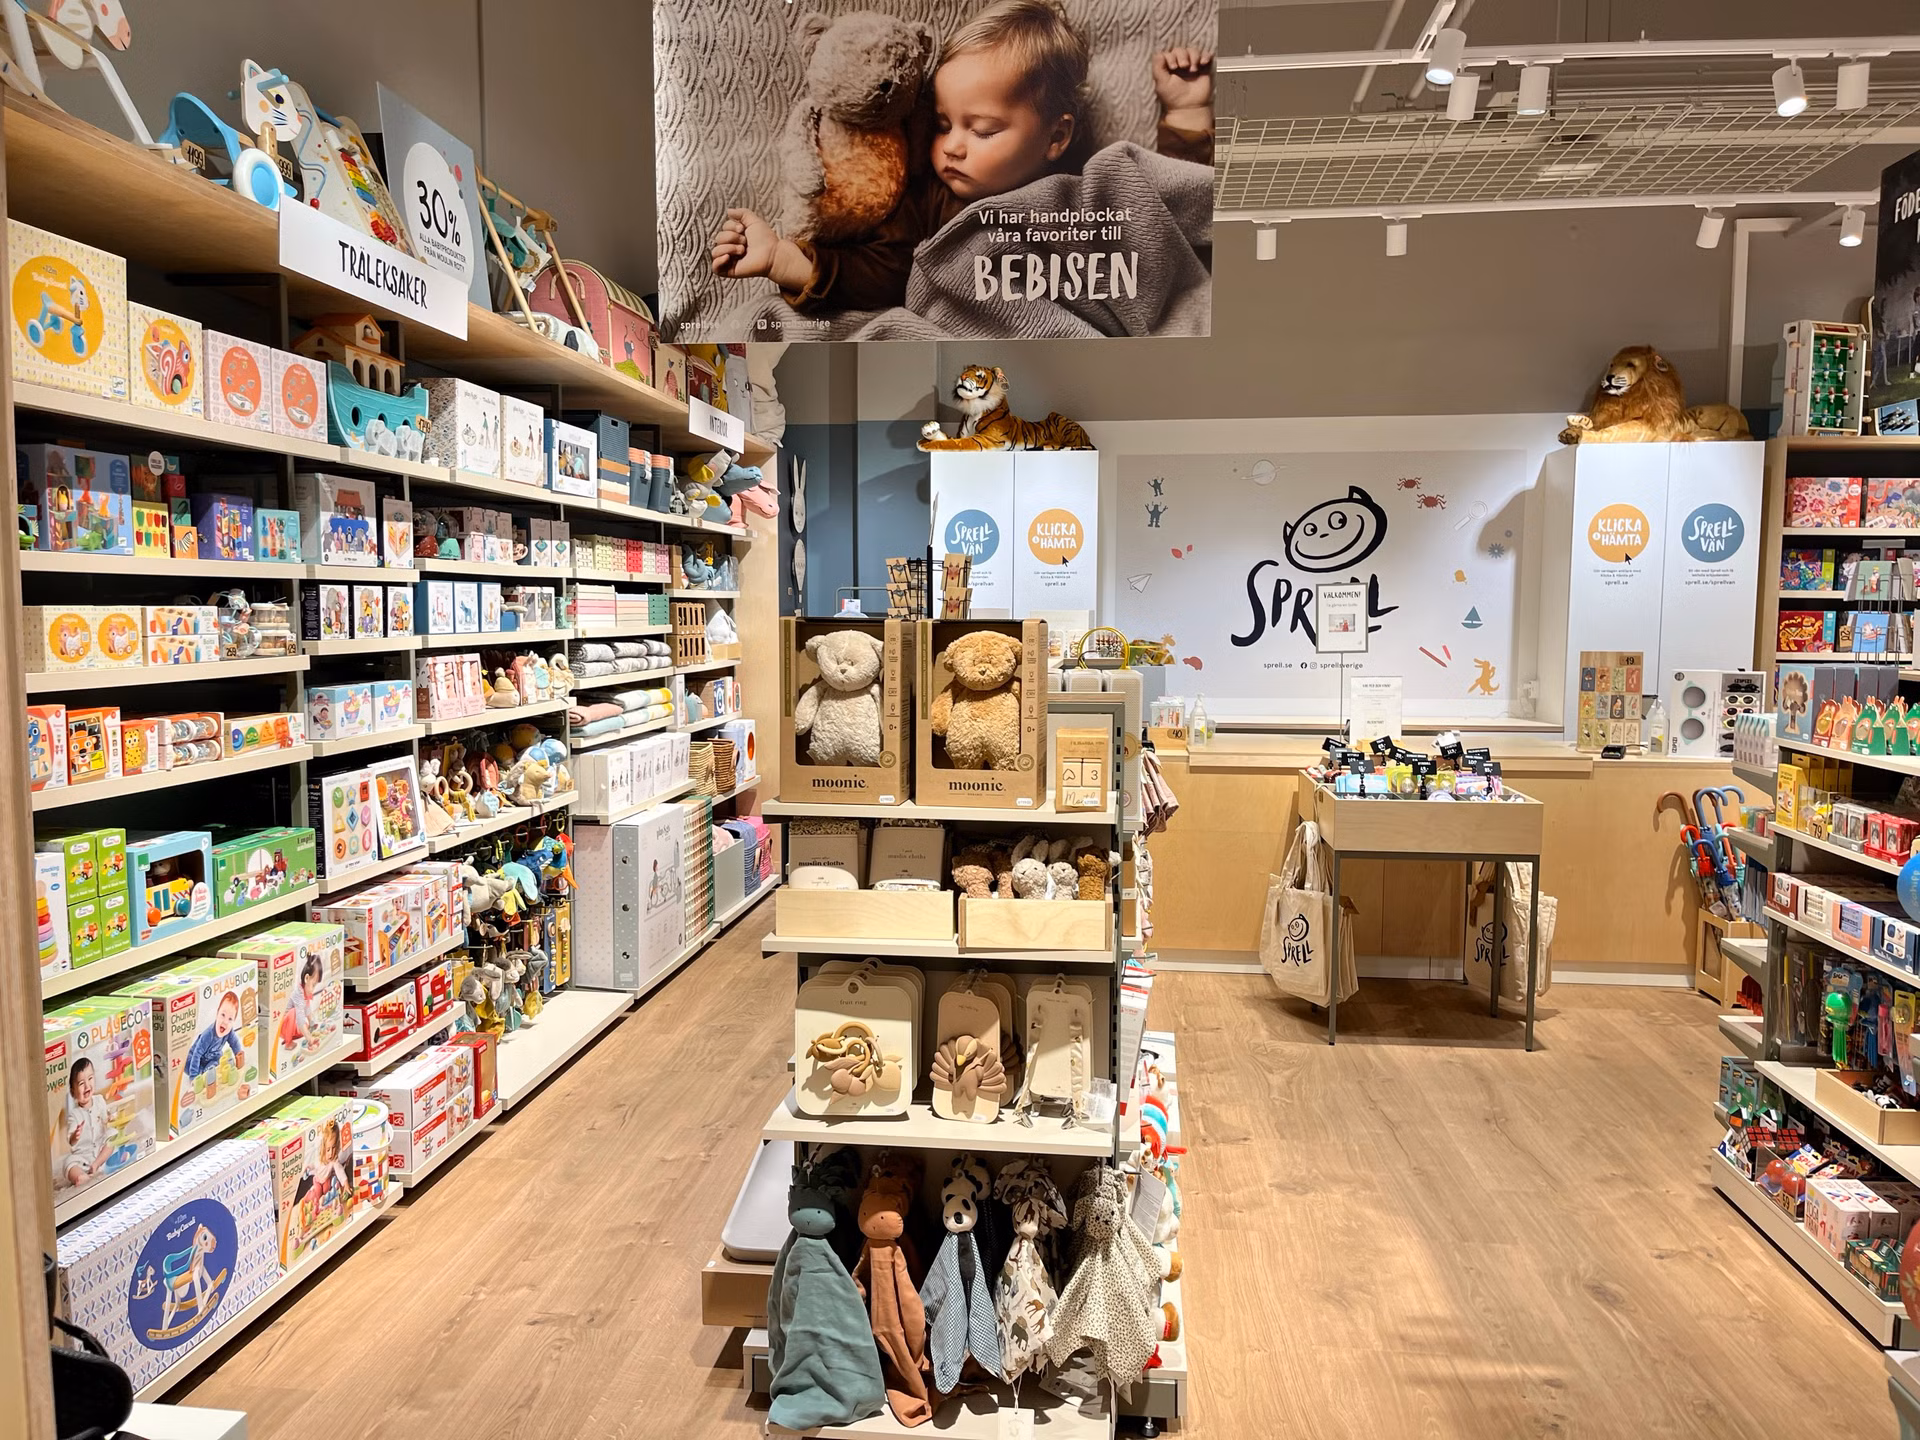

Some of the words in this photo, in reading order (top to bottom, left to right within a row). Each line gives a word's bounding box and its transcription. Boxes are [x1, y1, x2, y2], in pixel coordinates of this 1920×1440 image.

[417, 180, 460, 247] 30%
[978, 210, 994, 224] Vi
[999, 210, 1025, 224] har
[1030, 208, 1132, 226] handplockat
[988, 228, 1022, 243] våra
[1026, 226, 1097, 242] favoriter
[1101, 226, 1122, 241] till
[338, 240, 428, 310] TRÄLEKSAKER
[974, 252, 1138, 301] BEBISEN
[951, 520, 994, 545] SPRELL
[1036, 522, 1076, 536] KLICKA
[1598, 518, 1642, 532] KLICKA
[1688, 516, 1737, 541] SPRELL
[1040, 536, 1077, 549] HÄMTA
[1602, 532, 1642, 546] HÄMTA
[1700, 537, 1725, 552] VÄN
[961, 541, 983, 556] VÄN
[1230, 560, 1400, 647] SPRL
[1091, 770, 1098, 780] 3
[1812, 824, 1822, 838] 79
[1281, 936, 1314, 967] SPRELL
[273, 967, 294, 982] Fanta
[214, 971, 249, 996] PLAYBIO
[274, 978, 293, 993] Color
[171, 1007, 196, 1024] Chunky
[91, 1010, 150, 1042] PLAYECO+
[171, 1019, 196, 1036] Peggy
[146, 1137, 153, 1148] 10
[282, 1153, 302, 1171] Jumbo
[282, 1162, 303, 1182] Peggy
[1782, 1193, 1790, 1210] 59
[1806, 1200, 1819, 1222] YOGA
